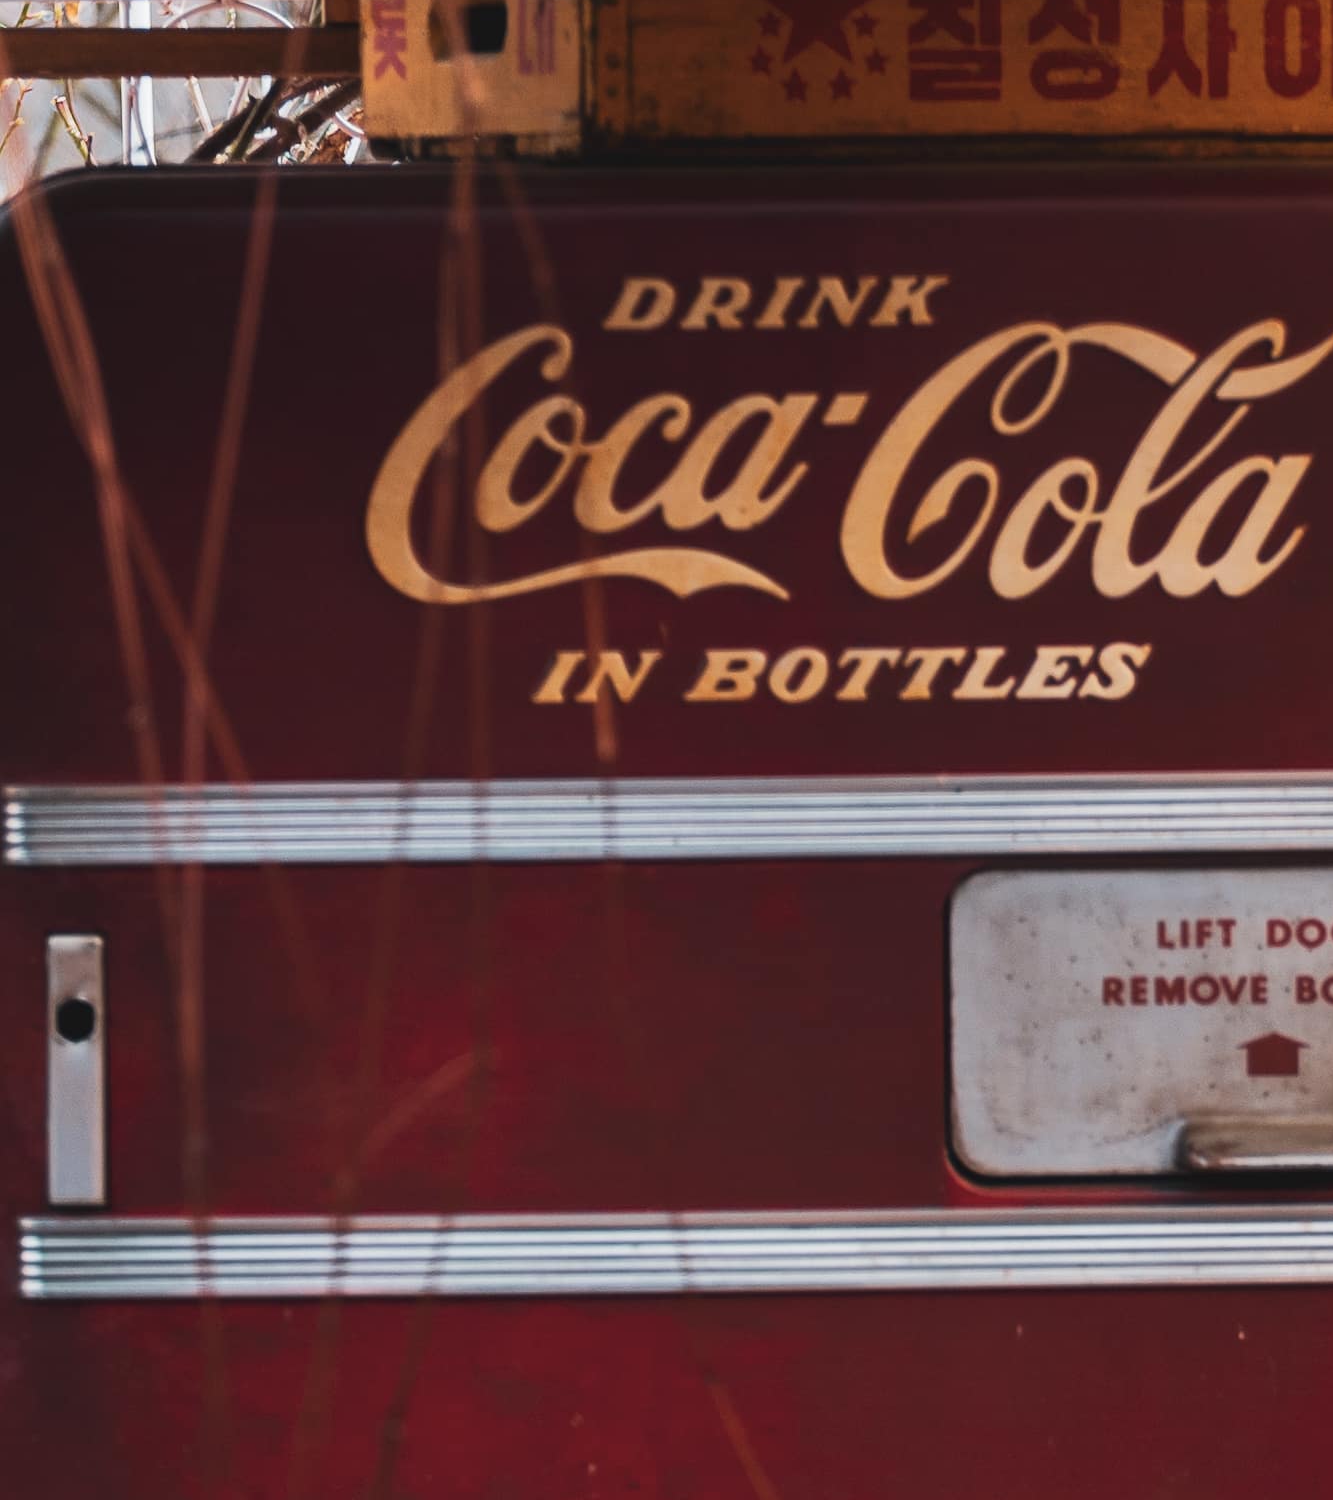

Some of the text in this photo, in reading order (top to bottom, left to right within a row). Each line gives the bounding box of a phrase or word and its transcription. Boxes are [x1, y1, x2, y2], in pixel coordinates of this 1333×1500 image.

[604, 276, 948, 331] DRINK
[531, 641, 1153, 705] IN BOTTLES
[1155, 916, 1241, 954] LIFT
[1101, 973, 1271, 1008] REMOVE
